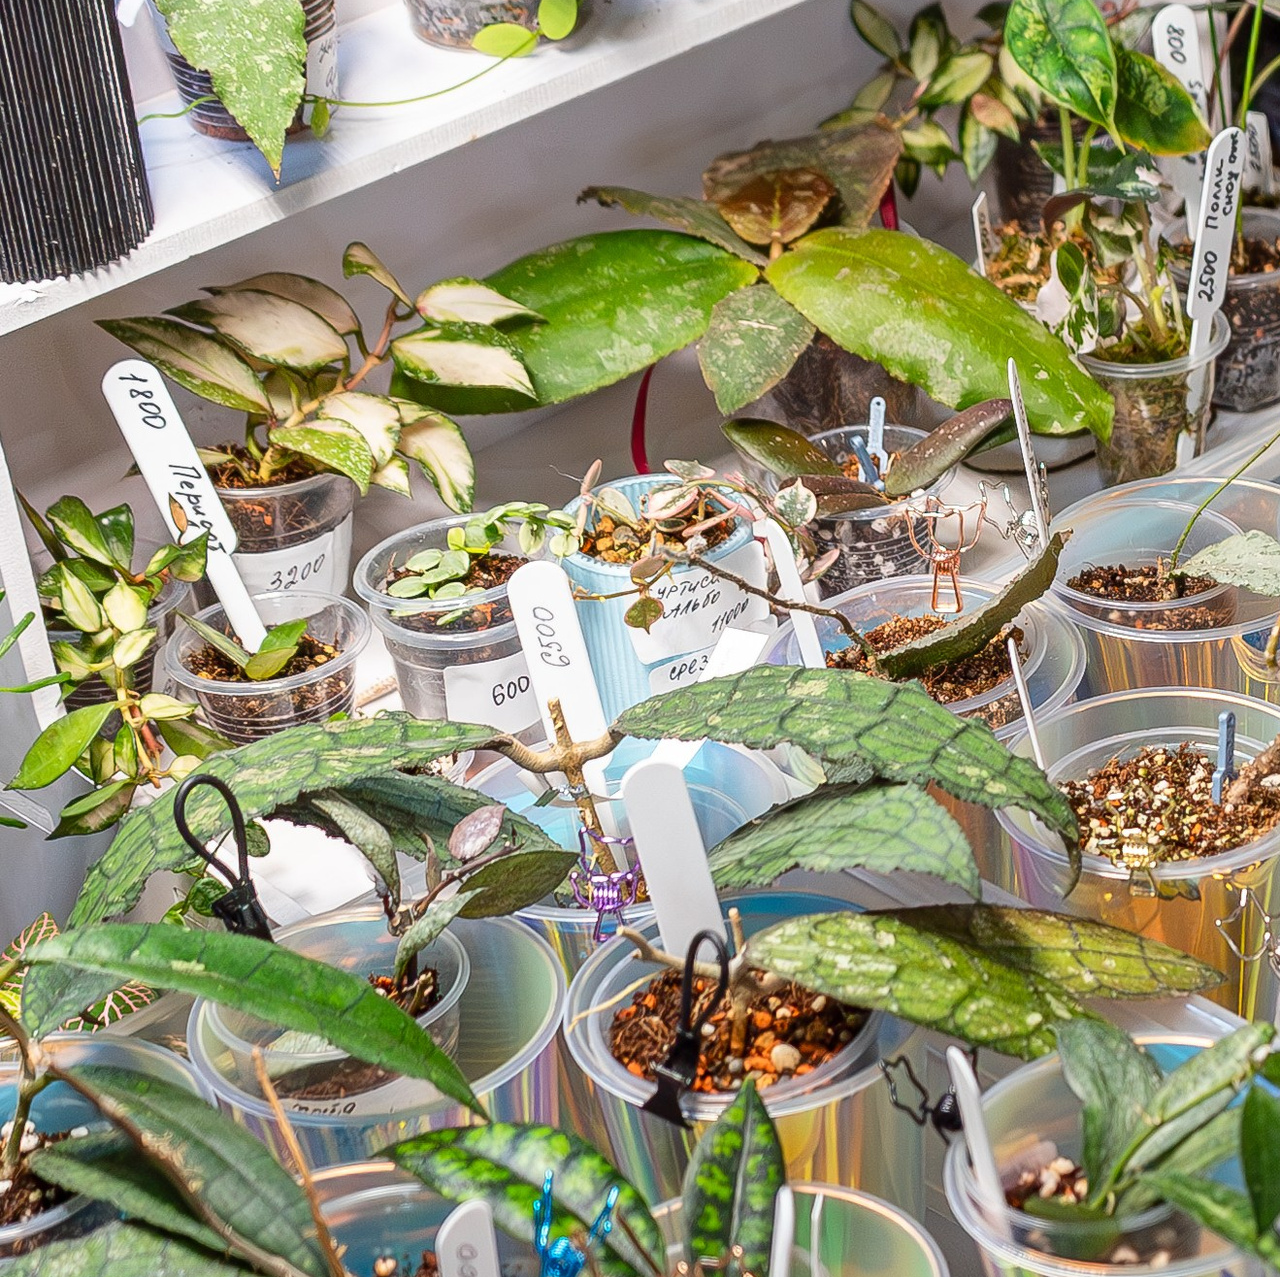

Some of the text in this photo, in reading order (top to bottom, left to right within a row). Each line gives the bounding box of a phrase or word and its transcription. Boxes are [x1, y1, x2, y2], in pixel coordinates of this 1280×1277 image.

[1166, 24, 1187, 64] 800
[1197, 250, 1218, 303] 2500
[118, 373, 167, 430] 1800
[266, 553, 326, 591] 3200
[532, 606, 571, 667] 6500
[492, 675, 530, 706] 600
